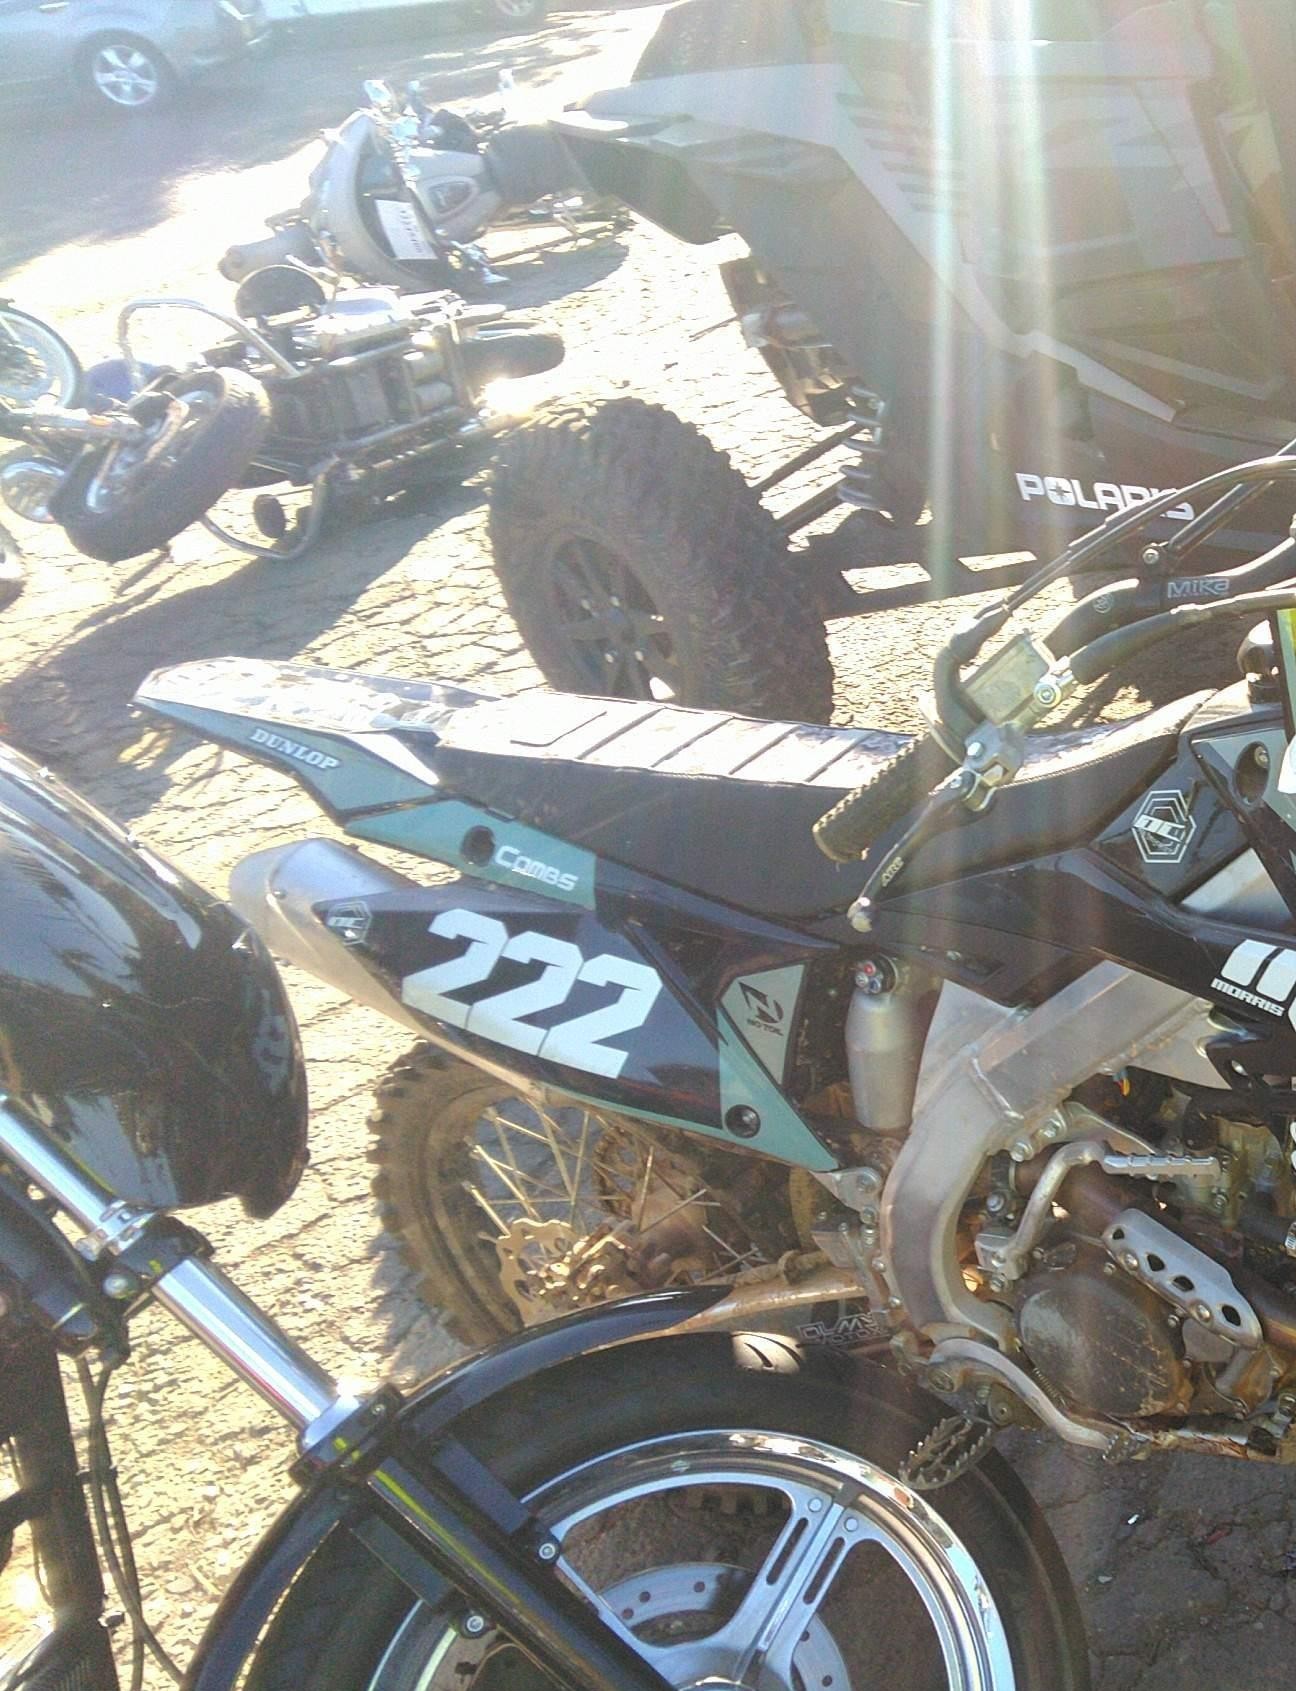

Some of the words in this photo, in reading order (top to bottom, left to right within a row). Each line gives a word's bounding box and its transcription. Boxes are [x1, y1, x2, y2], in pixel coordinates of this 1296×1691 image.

[249, 727, 341, 772] DUNLOP
[402, 908, 663, 1079] 222
[1210, 977, 1285, 1017] MORRIS
